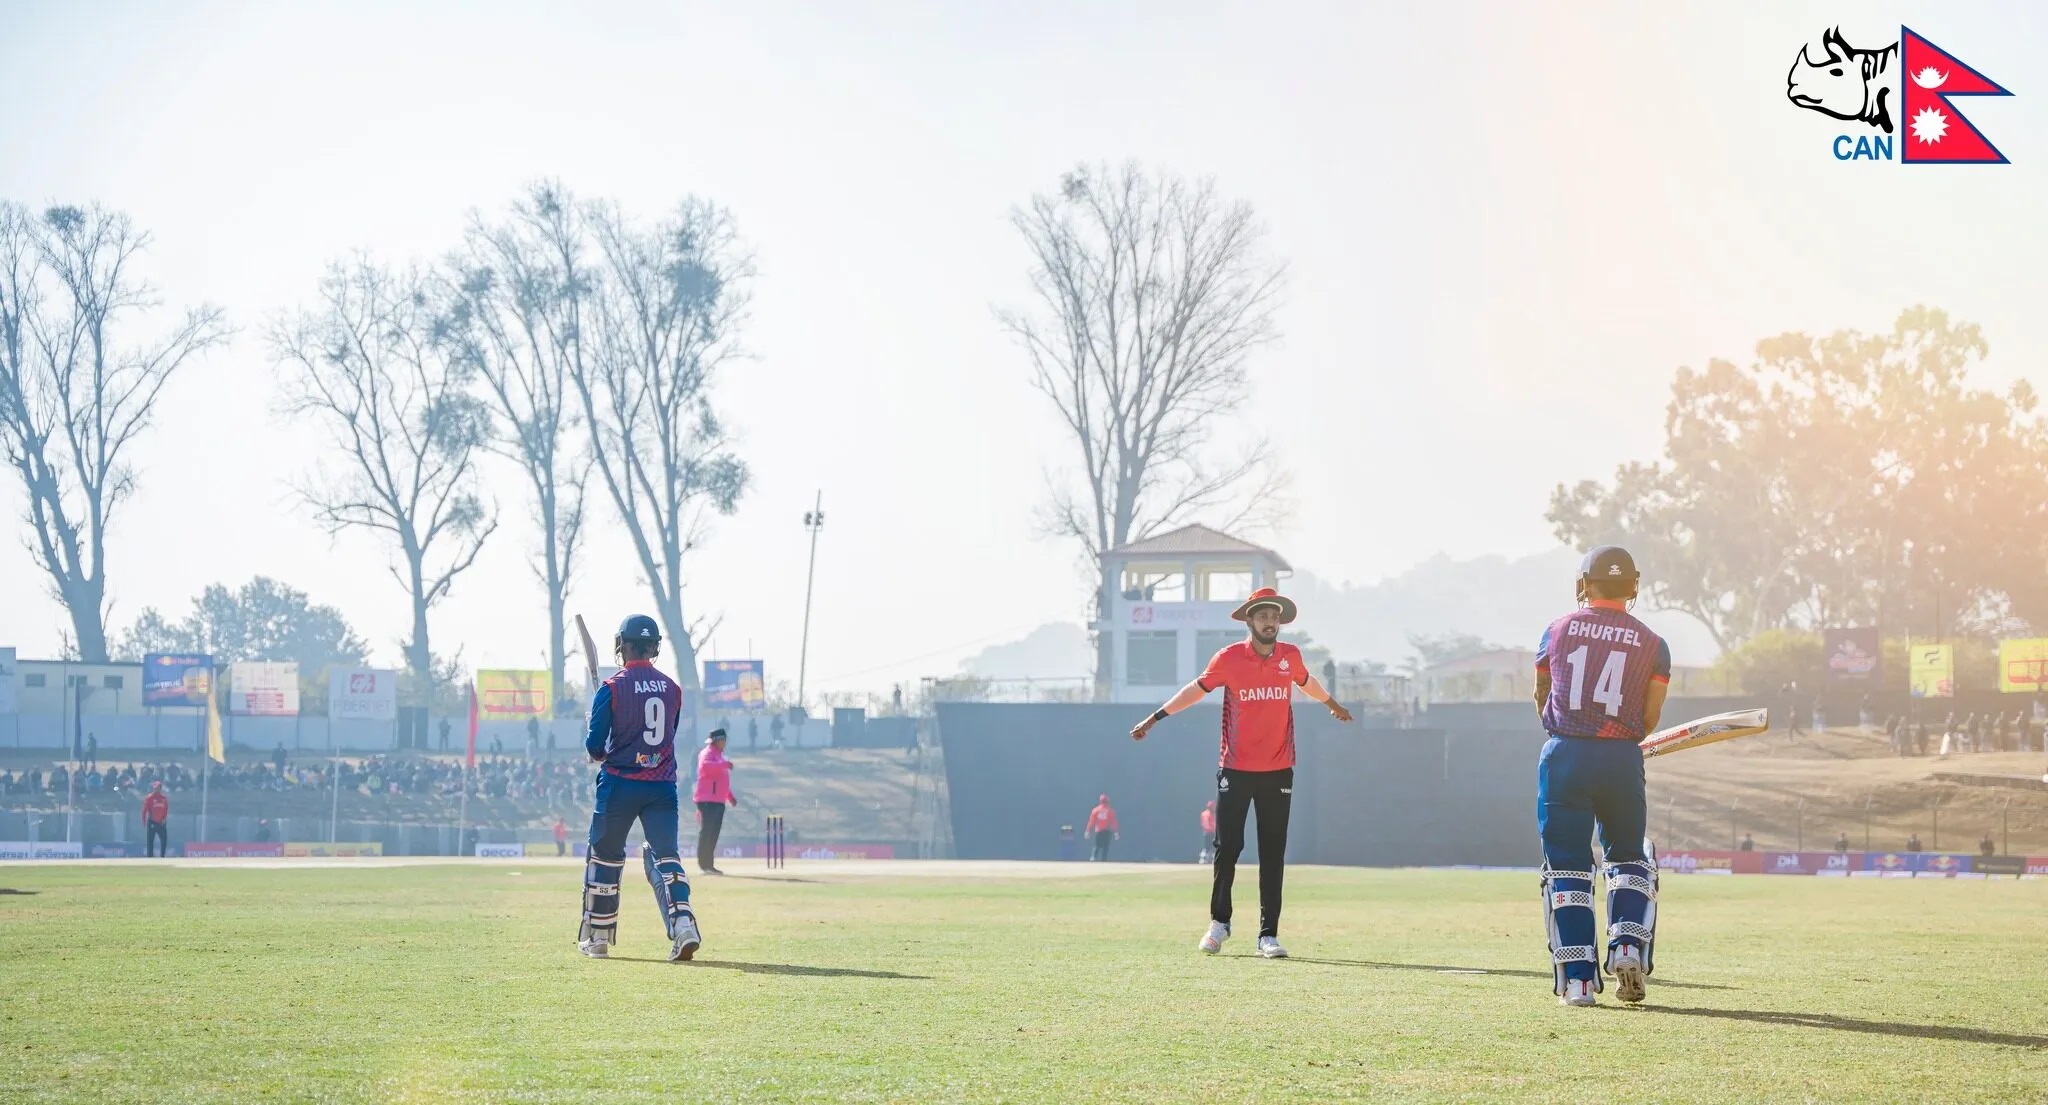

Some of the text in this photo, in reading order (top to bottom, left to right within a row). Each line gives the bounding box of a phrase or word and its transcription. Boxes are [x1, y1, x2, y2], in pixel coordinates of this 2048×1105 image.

[1568, 620, 1641, 647] BHURTEL
[634, 680, 667, 694] AASIF
[1239, 686, 1288, 702] CANADA
[1567, 645, 1627, 717] 14
[643, 697, 665, 746] 9
